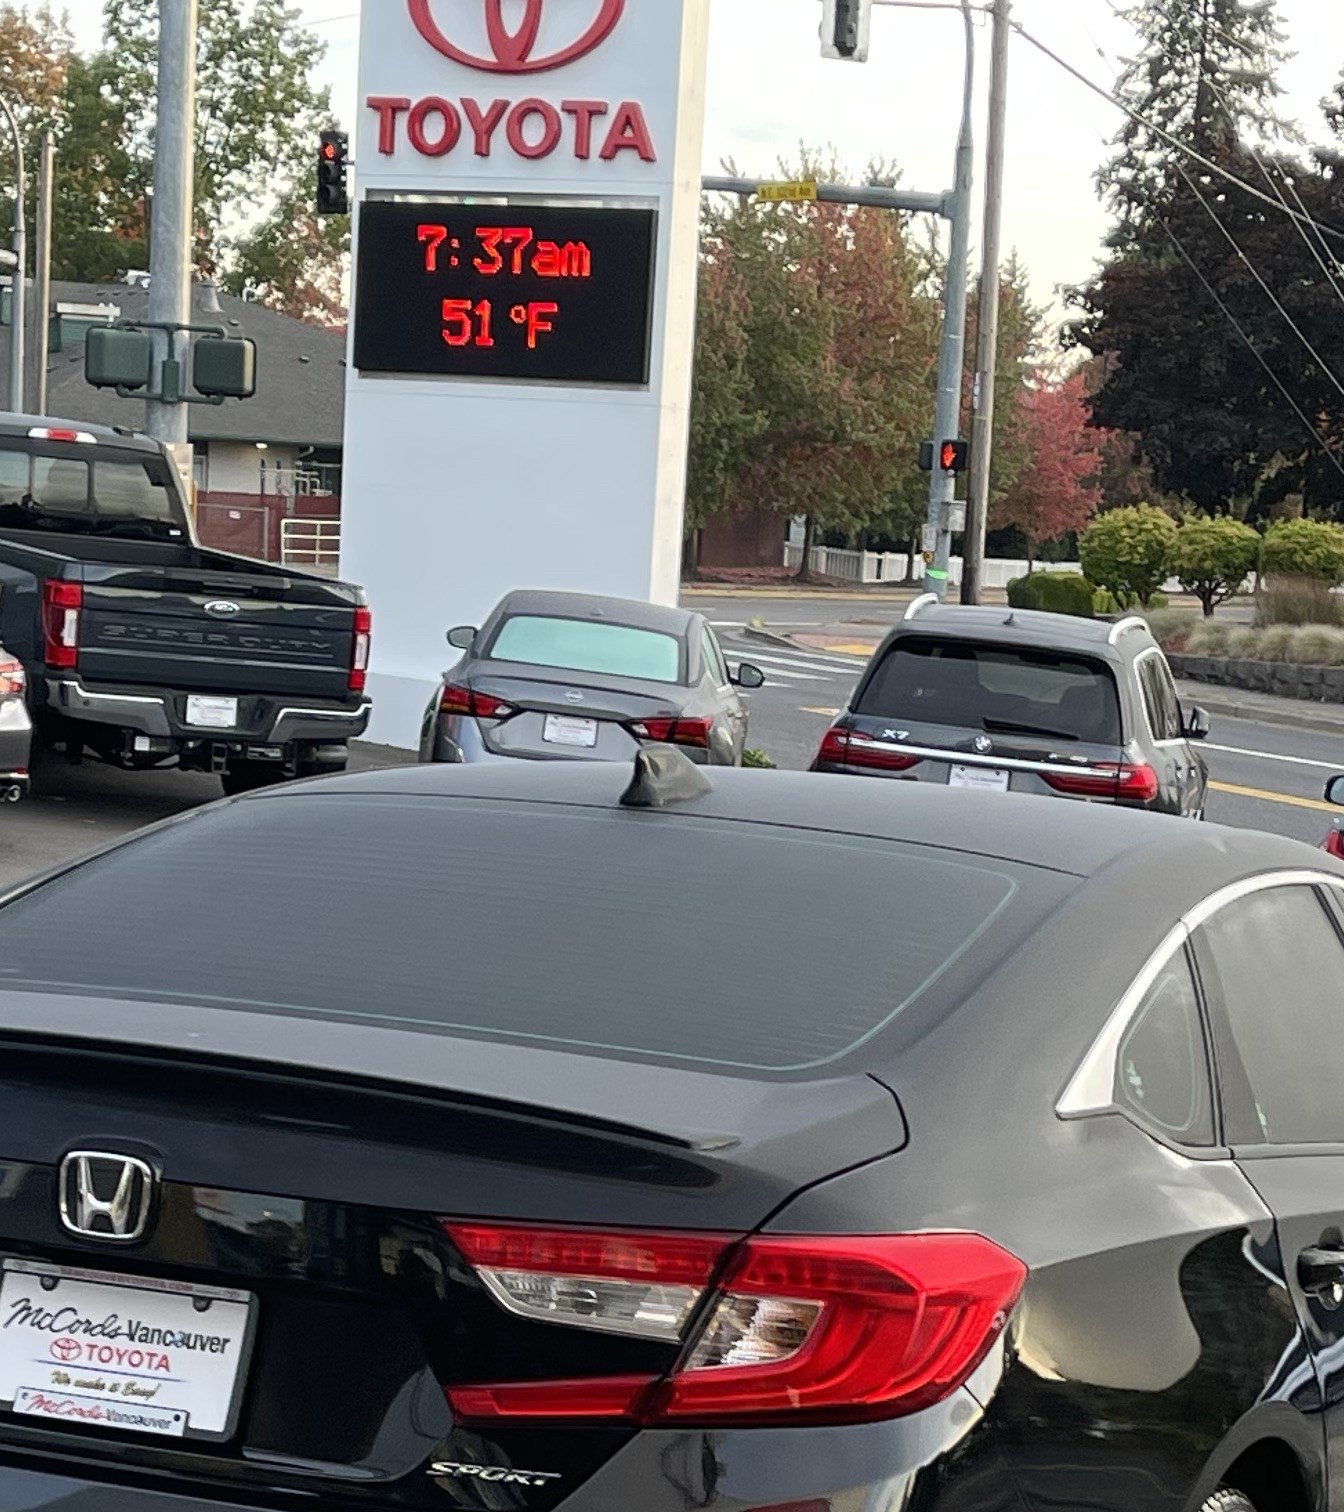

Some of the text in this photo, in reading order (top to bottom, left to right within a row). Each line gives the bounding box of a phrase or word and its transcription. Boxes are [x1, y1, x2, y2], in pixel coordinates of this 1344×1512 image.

[366, 96, 656, 162] TOYOTA
[441, 299, 495, 347] 51
[881, 728, 910, 740] X7
[3, 1297, 231, 1355] McCords Vancouver
[85, 1344, 171, 1372] TOYOTA
[25, 1393, 173, 1431] McCords Vancouver
[425, 1461, 562, 1486] SPORT
